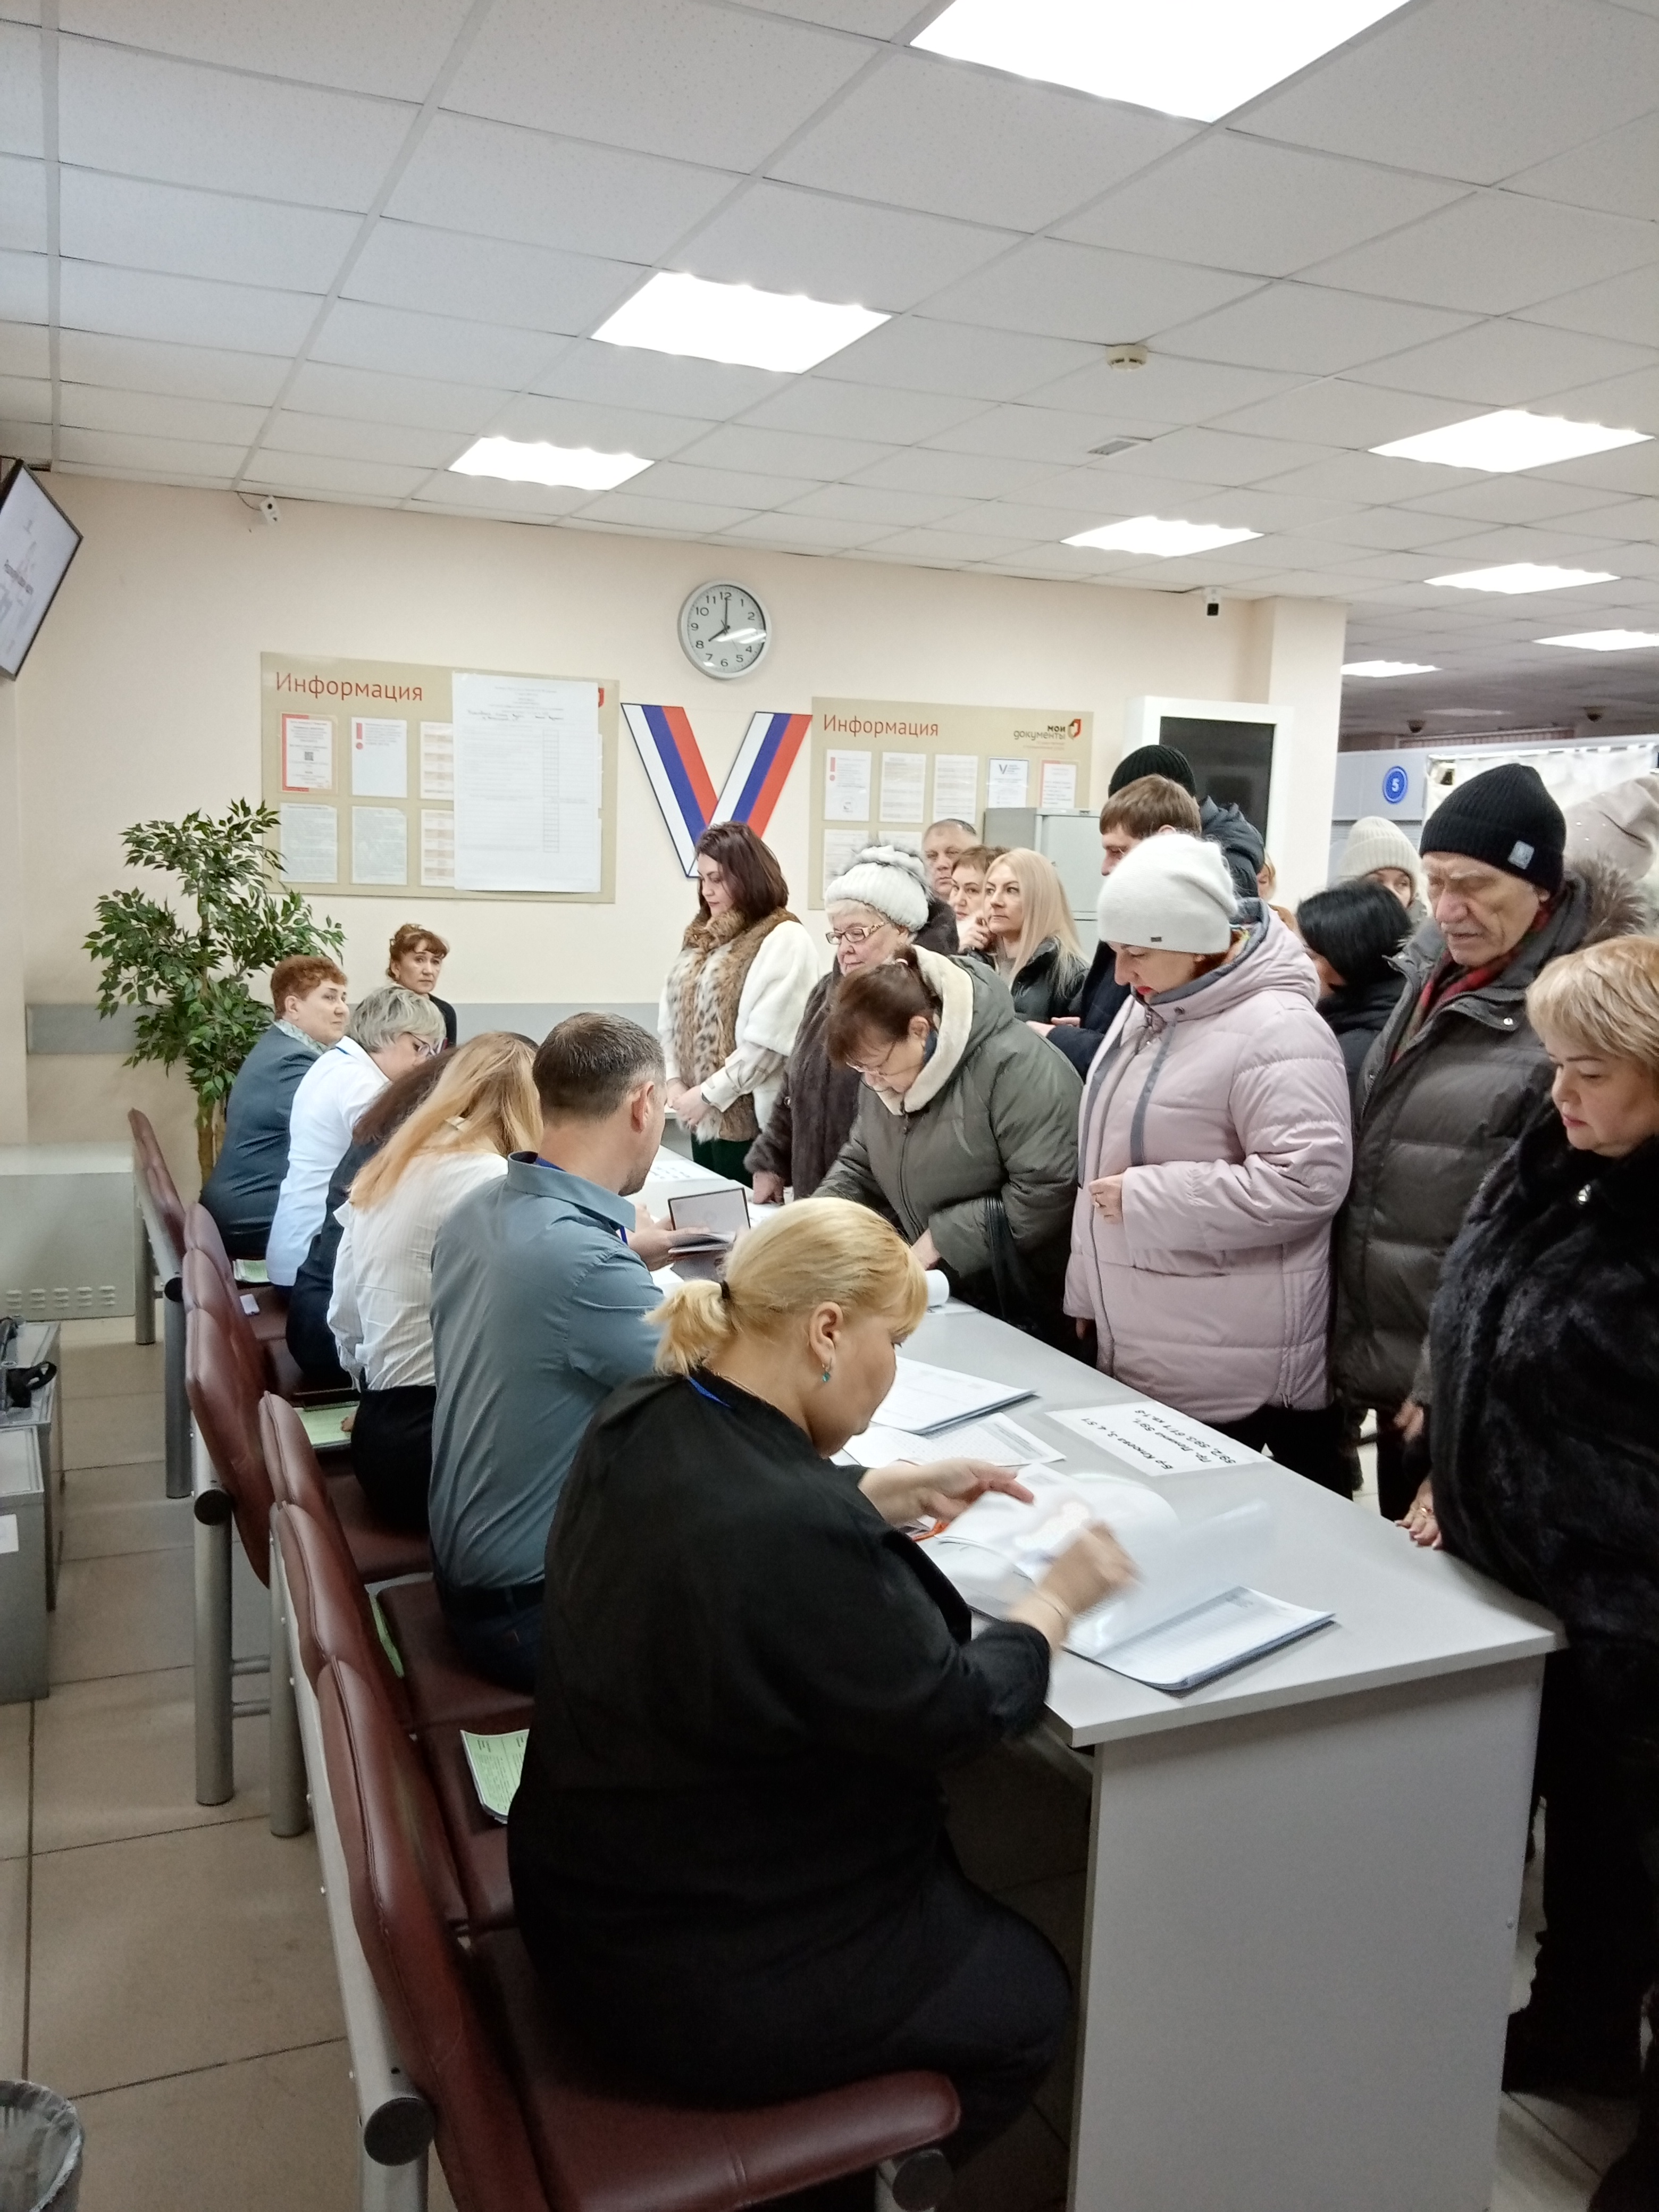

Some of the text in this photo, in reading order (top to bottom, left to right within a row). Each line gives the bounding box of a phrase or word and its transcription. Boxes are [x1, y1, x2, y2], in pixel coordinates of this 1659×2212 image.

[706, 595, 716, 604] 11
[719, 591, 732, 601] 12
[740, 598, 744, 607] 1
[696, 607, 709, 616] 10
[748, 612, 755, 621] 2
[696, 640, 704, 649] 8
[276, 671, 422, 702] Информация
[824, 714, 939, 738] Информация
[1013, 730, 1066, 741] документы
[1392, 778, 1400, 792] 5
